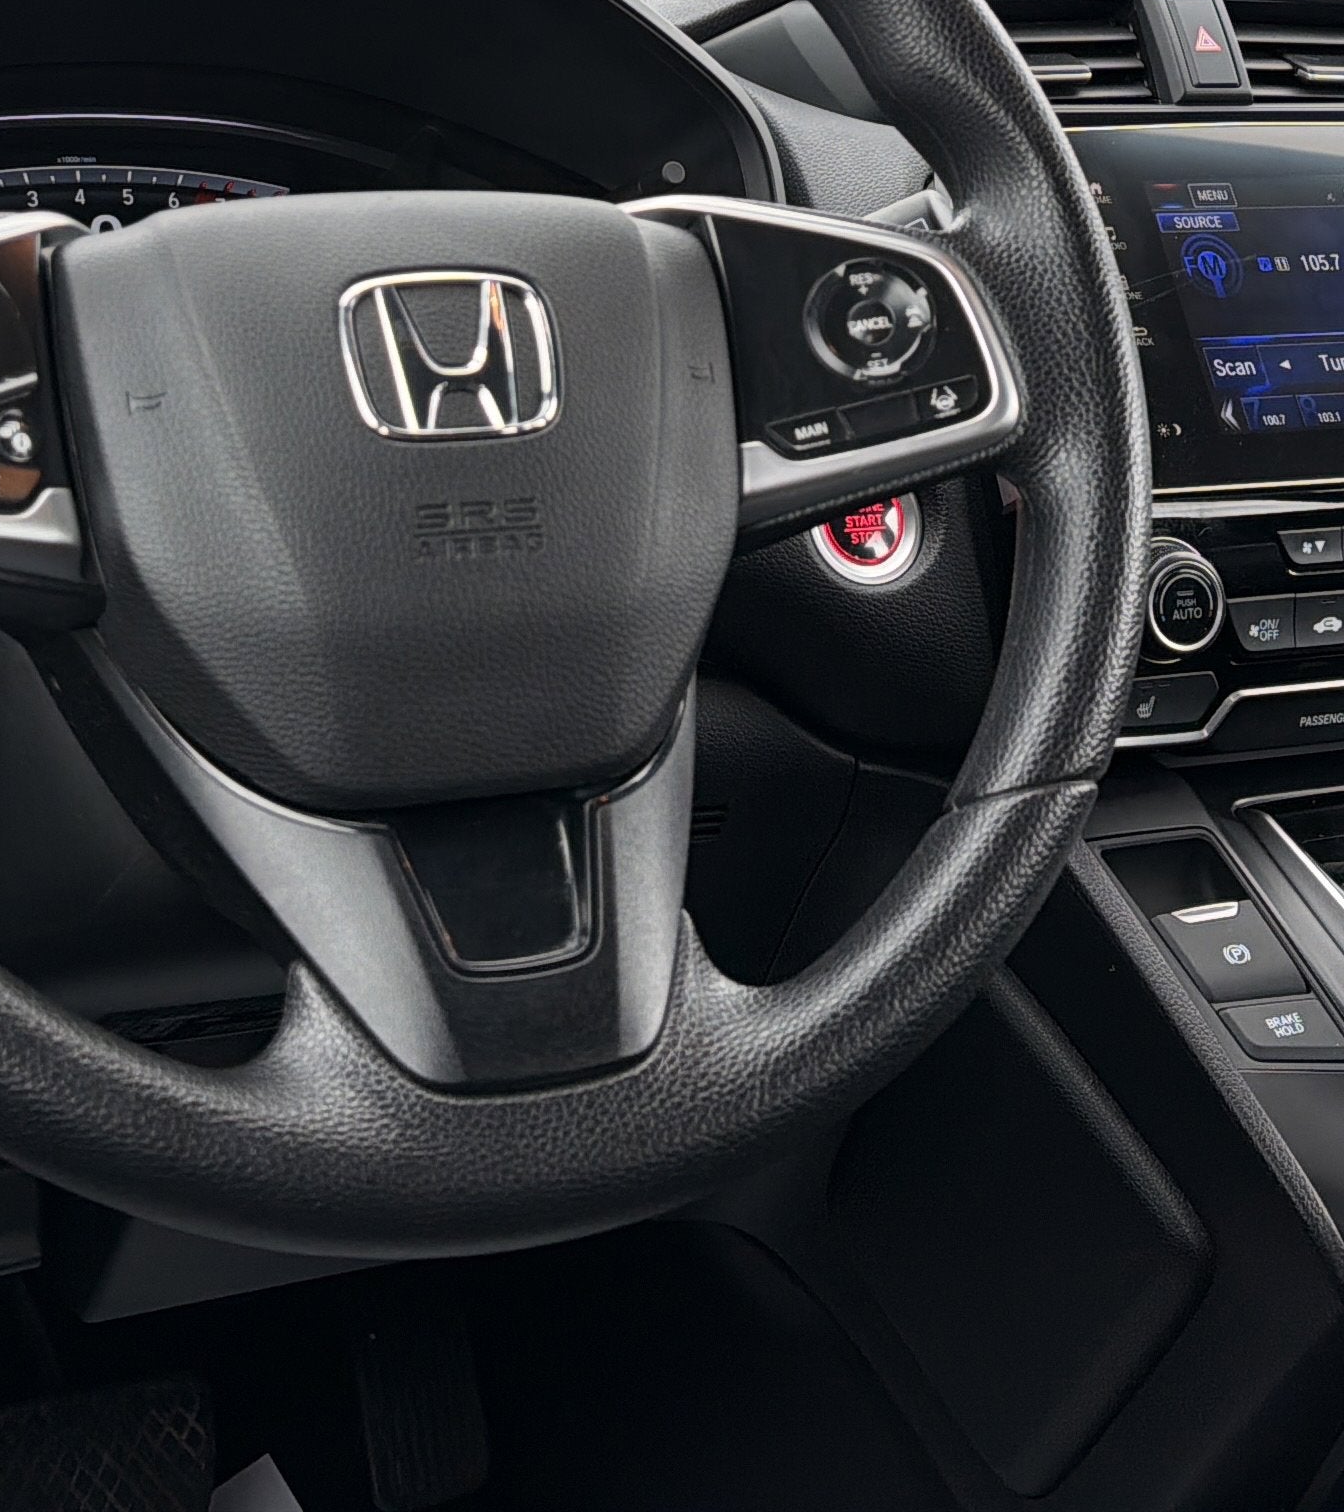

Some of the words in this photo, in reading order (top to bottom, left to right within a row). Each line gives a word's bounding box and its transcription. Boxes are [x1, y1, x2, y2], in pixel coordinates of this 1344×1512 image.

[26, 190, 40, 207] 3
[74, 188, 87, 205] 4
[122, 188, 134, 206] 5
[168, 191, 180, 209] 6
[1092, 195, 1113, 205] OME
[1196, 190, 1229, 202] MENU
[1172, 215, 1224, 229] SOURCE
[1300, 252, 1341, 272] 105.7
[1136, 337, 1155, 347] ACK
[1212, 358, 1257, 377] Scan
[1262, 413, 1286, 426] 100.7
[1317, 411, 1342, 424] 103.1
[793, 420, 830, 441] MAIN
[844, 513, 883, 528] START
[1176, 598, 1197, 607] PUSH
[1172, 606, 1203, 621] AUTO
[1259, 618, 1280, 630] ON/
[1259, 629, 1280, 642] OFF
[1264, 1011, 1303, 1030] BRAKE
[1273, 1022, 1306, 1039] HOLD
